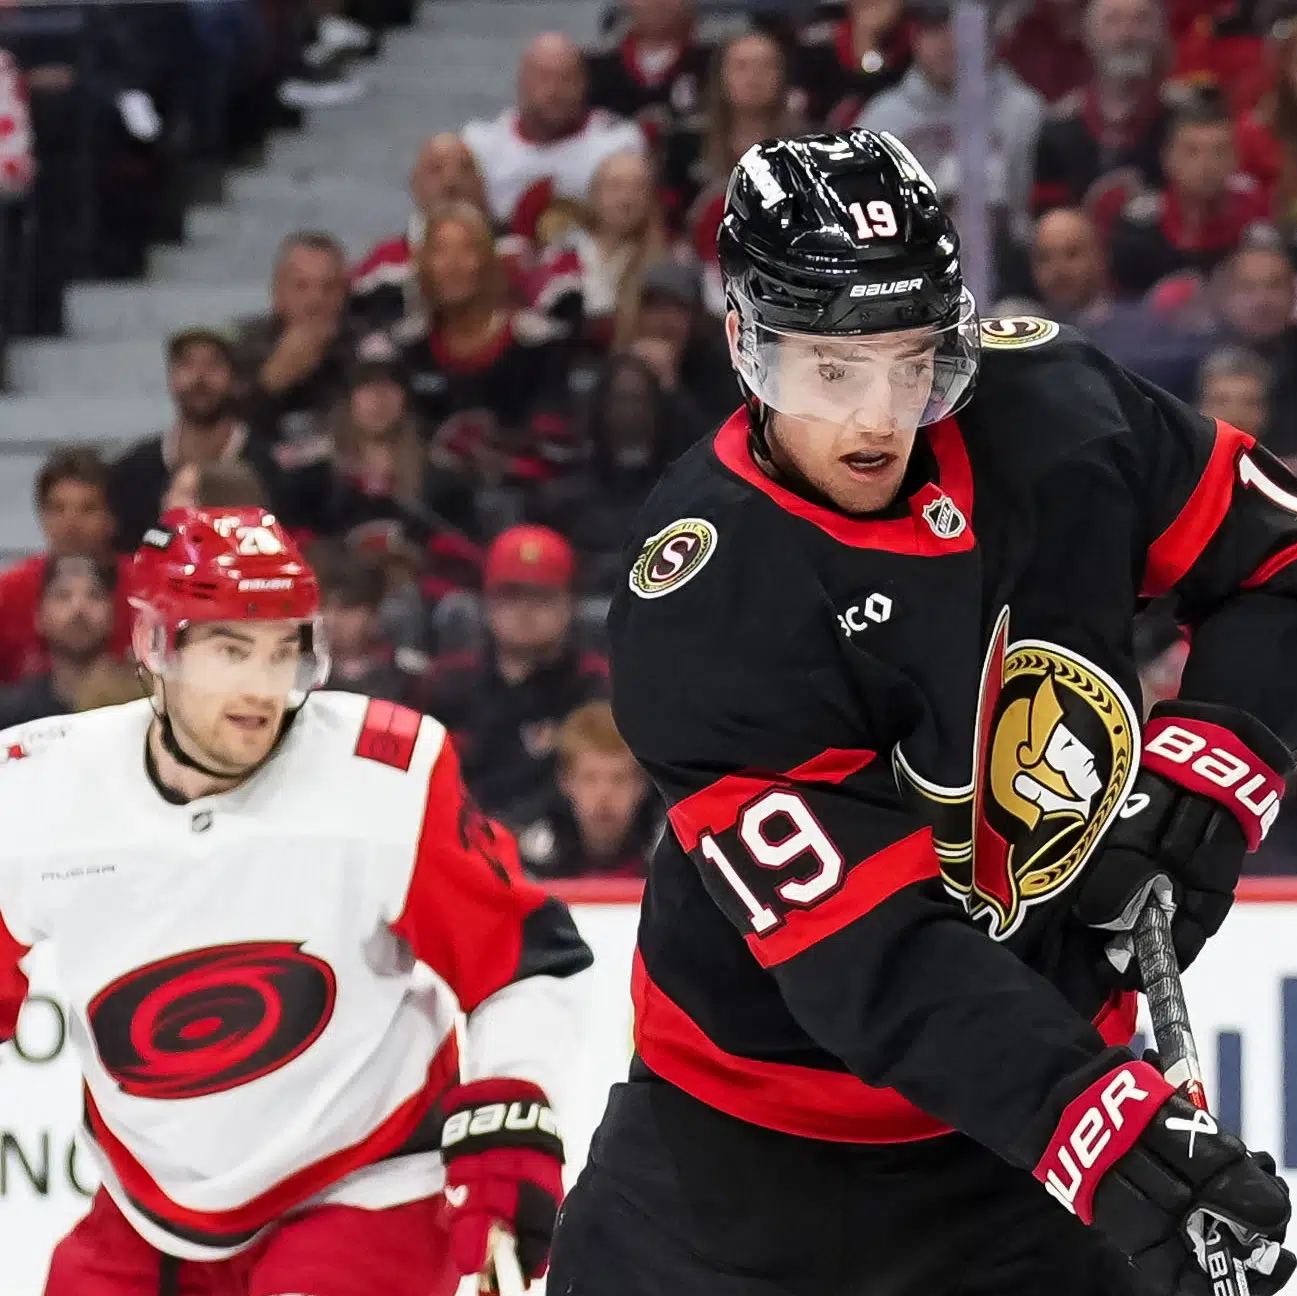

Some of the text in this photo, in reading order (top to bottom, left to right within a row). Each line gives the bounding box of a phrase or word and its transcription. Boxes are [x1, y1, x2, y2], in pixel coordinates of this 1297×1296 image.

[849, 200, 899, 240] 19
[850, 278, 924, 297] BAUER
[650, 537, 697, 579] S
[700, 788, 845, 936] 19
